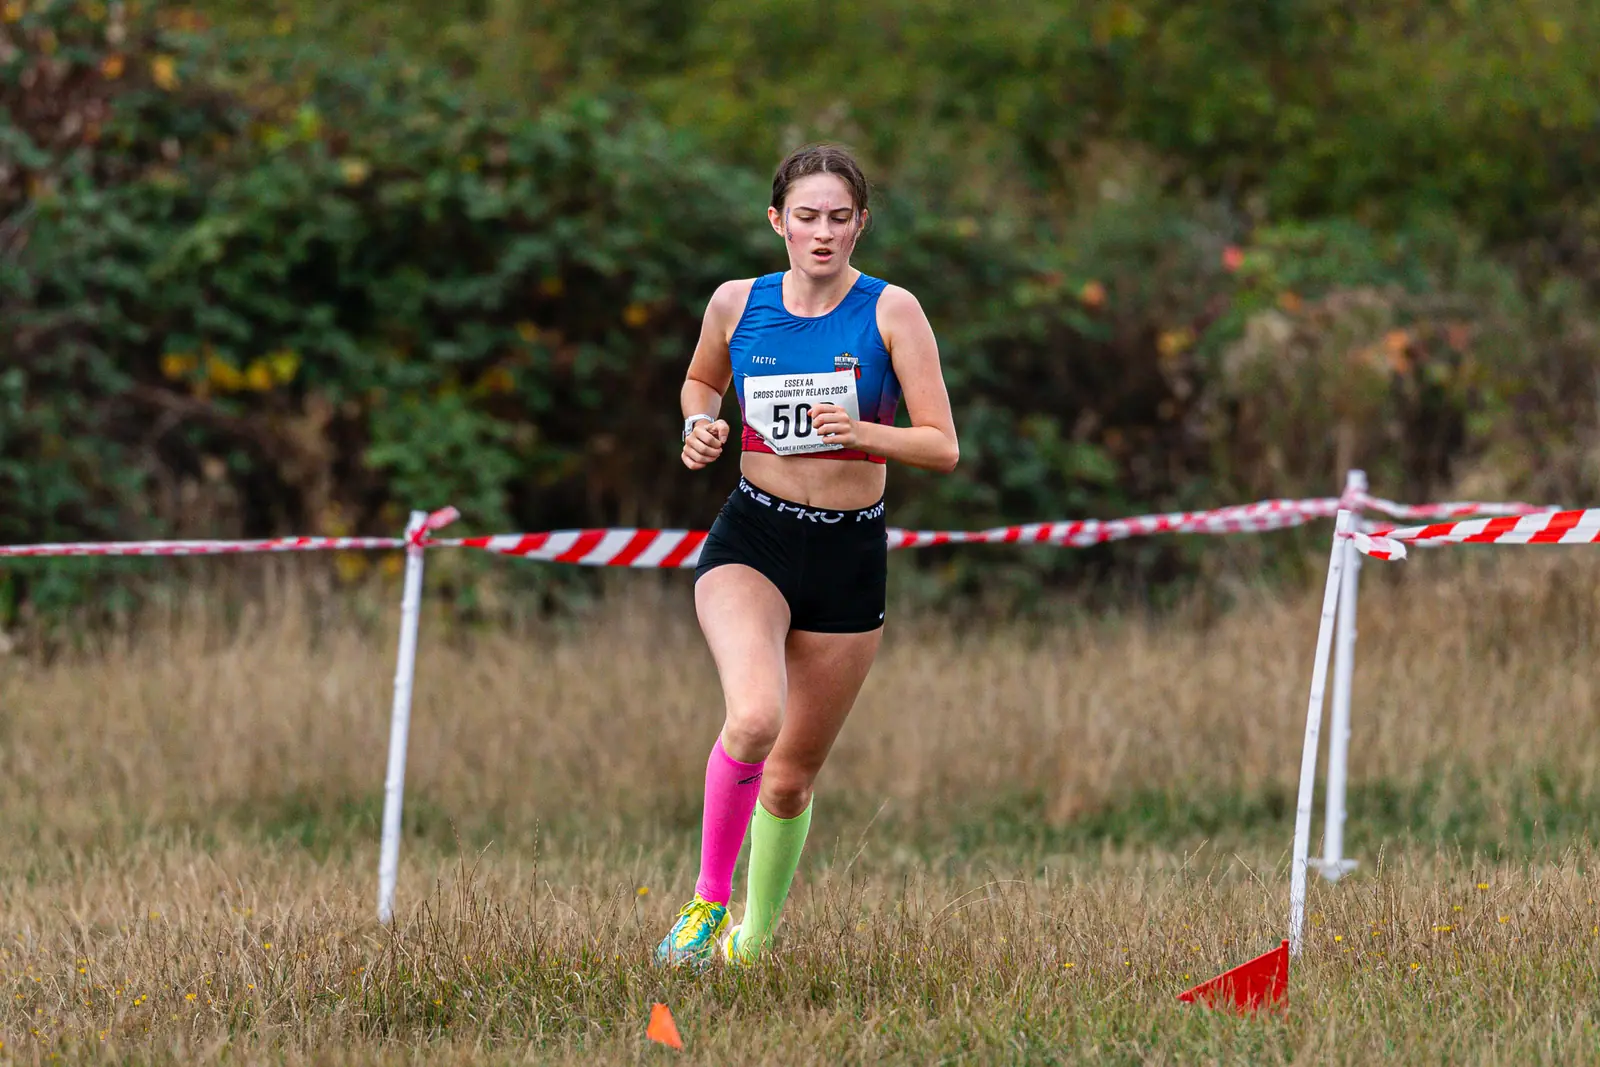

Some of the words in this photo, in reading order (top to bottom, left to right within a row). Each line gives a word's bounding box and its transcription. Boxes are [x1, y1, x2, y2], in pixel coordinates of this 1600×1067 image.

[752, 355, 777, 365] TACTIC
[784, 379, 804, 388] ESSEX
[805, 378, 814, 387] AA
[753, 390, 774, 399] CROSS
[775, 389, 804, 399] COUNTRY
[805, 387, 830, 397] RELAYS
[830, 385, 848, 395] 2026
[772, 402, 835, 440] 50
[777, 502, 844, 524] PRO
